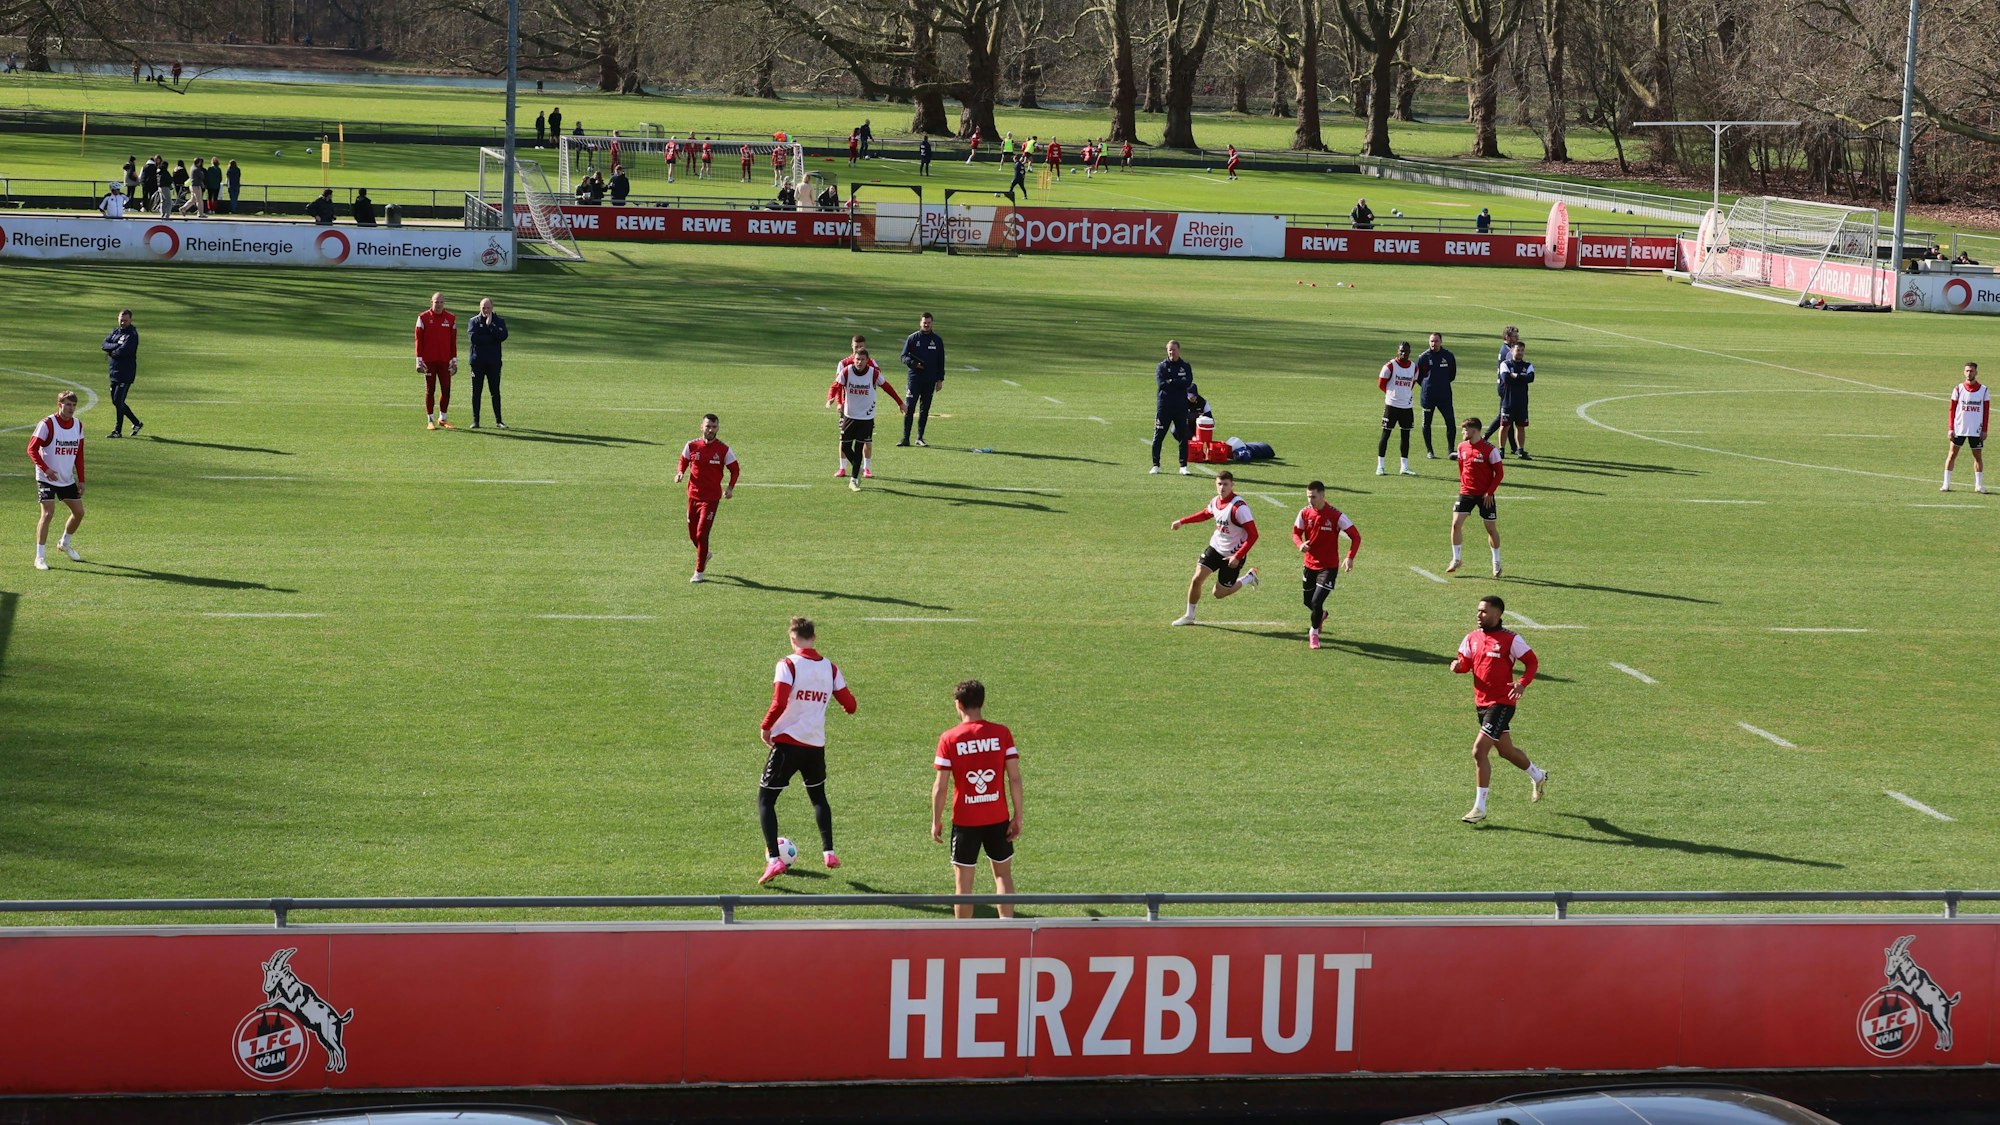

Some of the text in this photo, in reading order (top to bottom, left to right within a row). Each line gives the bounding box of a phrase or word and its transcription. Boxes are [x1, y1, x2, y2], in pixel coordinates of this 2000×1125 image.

[549, 214, 599, 229] REWE
[616, 215, 665, 231] REWE
[681, 217, 731, 233] REWE
[747, 219, 797, 235] REWE
[925, 212, 972, 228] Rhein
[919, 224, 982, 242] Energie
[1003, 212, 1162, 250] Sportpark
[1189, 222, 1234, 237] Rhein
[12, 232, 121, 251] RheinEnergie
[185, 237, 293, 256] RheinEnergie
[356, 241, 462, 259] RheinEnergie
[1183, 233, 1244, 251] Energie
[1302, 236, 1546, 257] REWE REWE REWE REW
[1582, 244, 1627, 259] REWE
[1631, 245, 1675, 261] REWE
[1852, 272, 1891, 303] ANDRS.
[849, 388, 870, 396] REWE
[1961, 405, 1982, 413] REWE
[54, 447, 78, 456] REWE
[795, 689, 828, 704] REWE
[956, 737, 1001, 756] REWE
[964, 791, 999, 805] hummel
[888, 952, 1373, 1060] HERZBLUT
[1870, 1009, 1908, 1034] 1.FC
[249, 1029, 293, 1056] 1.FC
[1874, 1029, 1902, 1046] KÖLN
[254, 1050, 286, 1070] KÖLN
